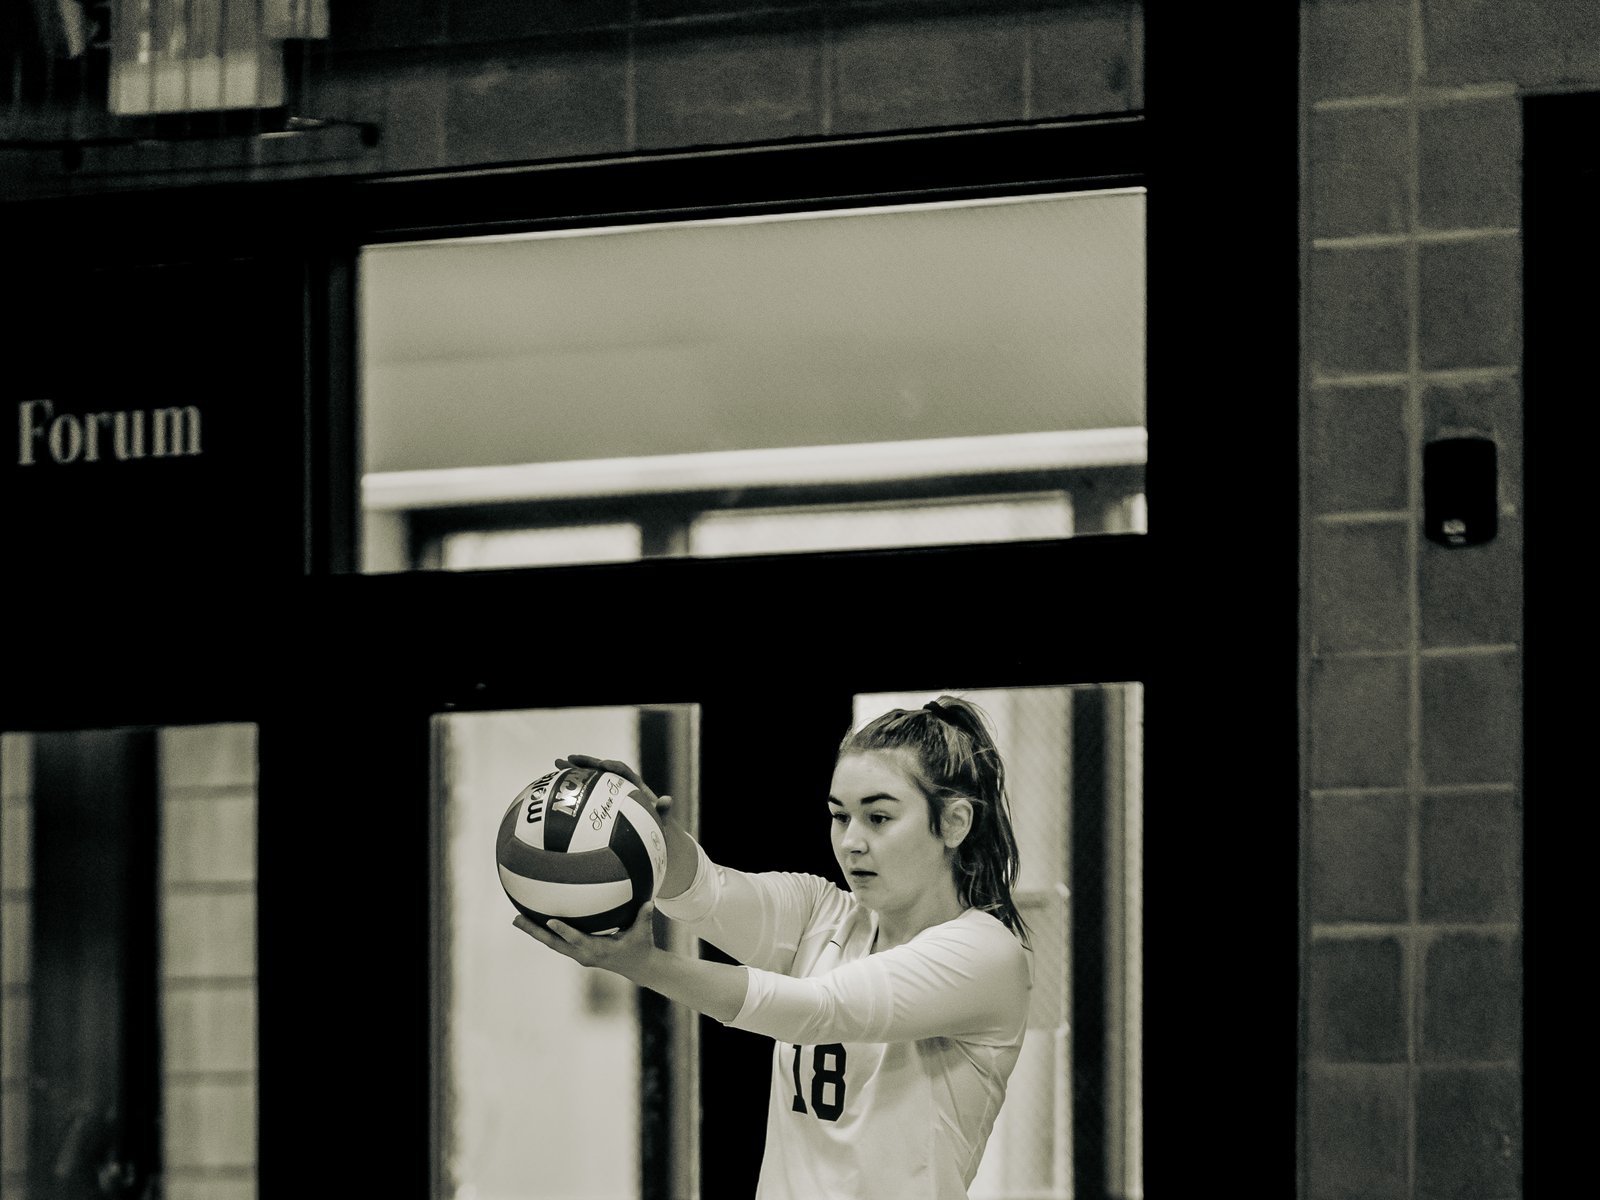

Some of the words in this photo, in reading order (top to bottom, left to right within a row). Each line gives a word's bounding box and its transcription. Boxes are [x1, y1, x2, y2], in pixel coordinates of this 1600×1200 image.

[17, 399, 203, 466] Forum
[527, 770, 560, 824] molte
[589, 796, 614, 831] Super
[791, 1042, 847, 1123] 18
